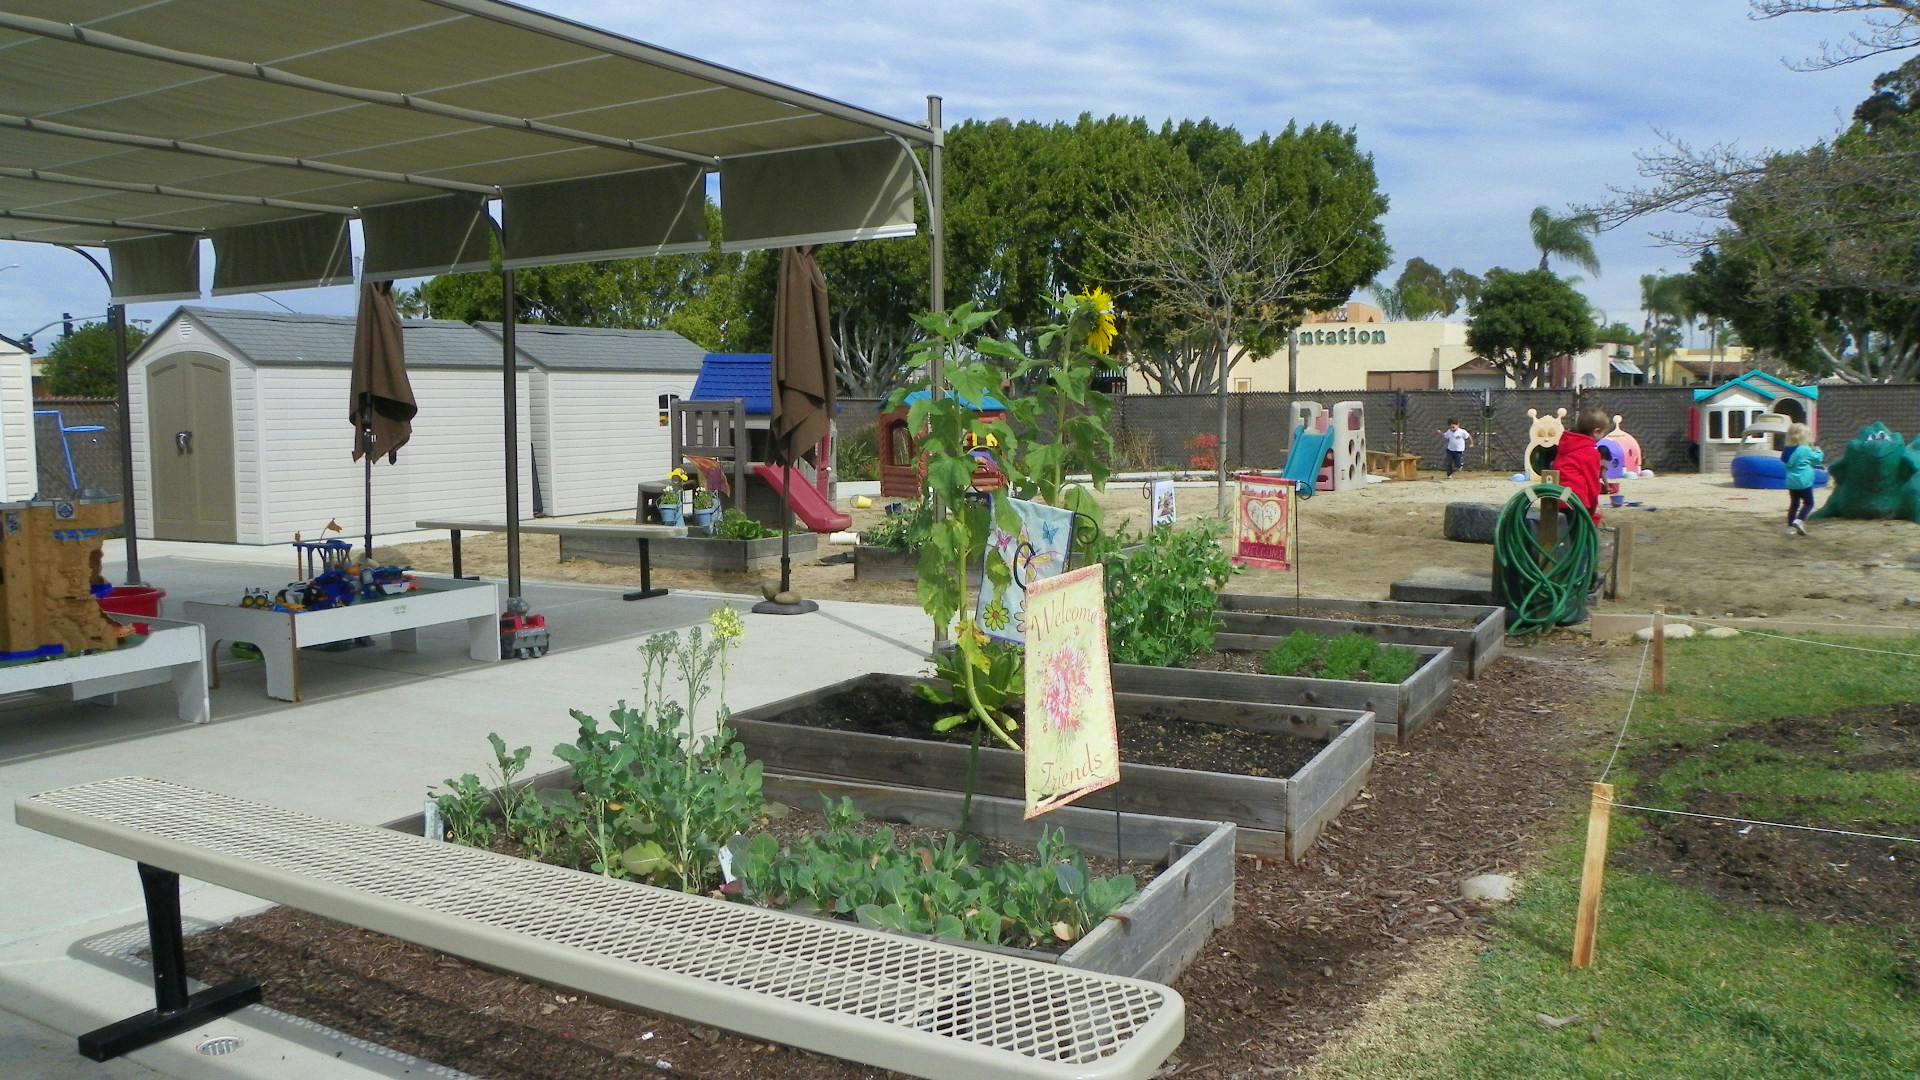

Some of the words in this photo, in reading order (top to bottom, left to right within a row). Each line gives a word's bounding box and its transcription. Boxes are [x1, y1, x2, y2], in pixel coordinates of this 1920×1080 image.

[1297, 327, 1386, 346] ntation
[1242, 544, 1285, 559] WELCOME
[1031, 592, 1097, 641] Welcome
[1034, 743, 1105, 794] Friends
